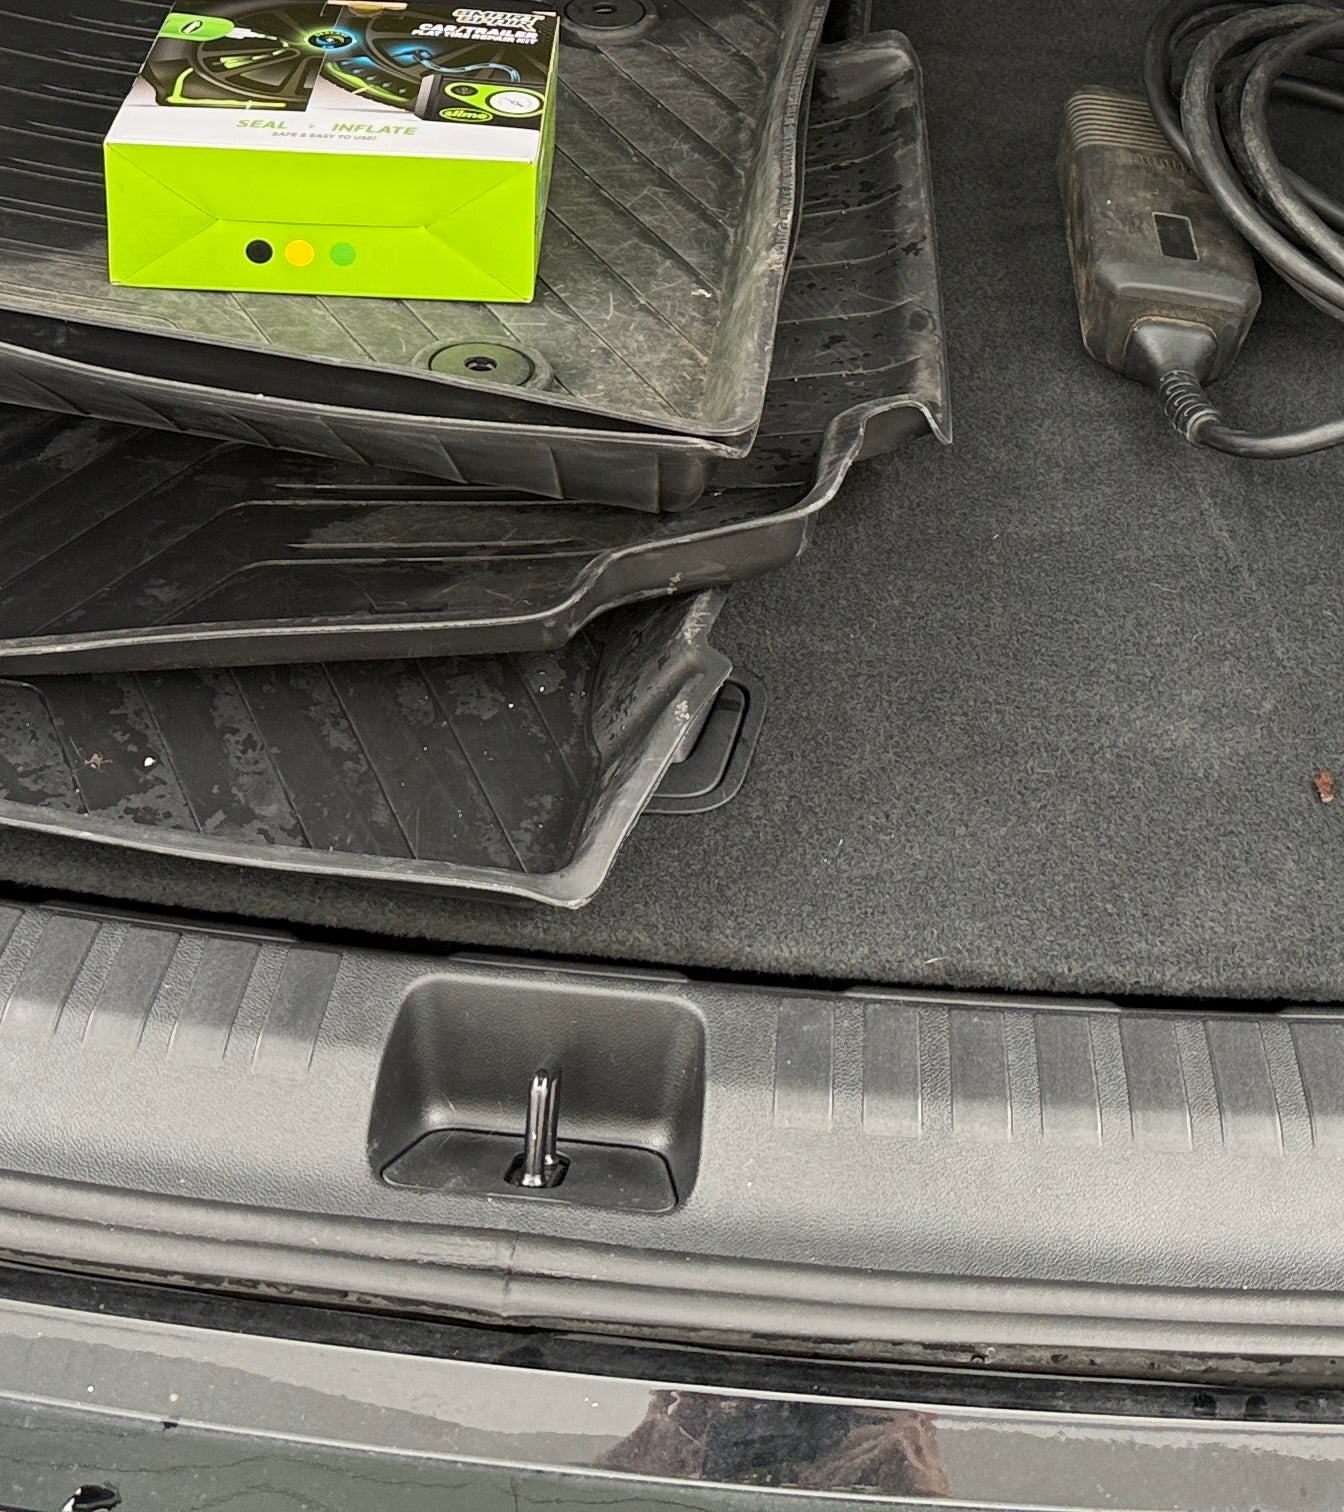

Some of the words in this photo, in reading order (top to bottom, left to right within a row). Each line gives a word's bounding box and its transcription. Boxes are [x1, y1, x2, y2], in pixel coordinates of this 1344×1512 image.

[411, 29, 443, 37] FLAT
[471, 33, 515, 43] REPAIR
[515, 37, 539, 45] KIT
[418, 23, 539, 39] CAR/TRAILER
[443, 109, 489, 120] slime
[236, 119, 288, 129] SEAL
[331, 123, 418, 136] INFLATE
